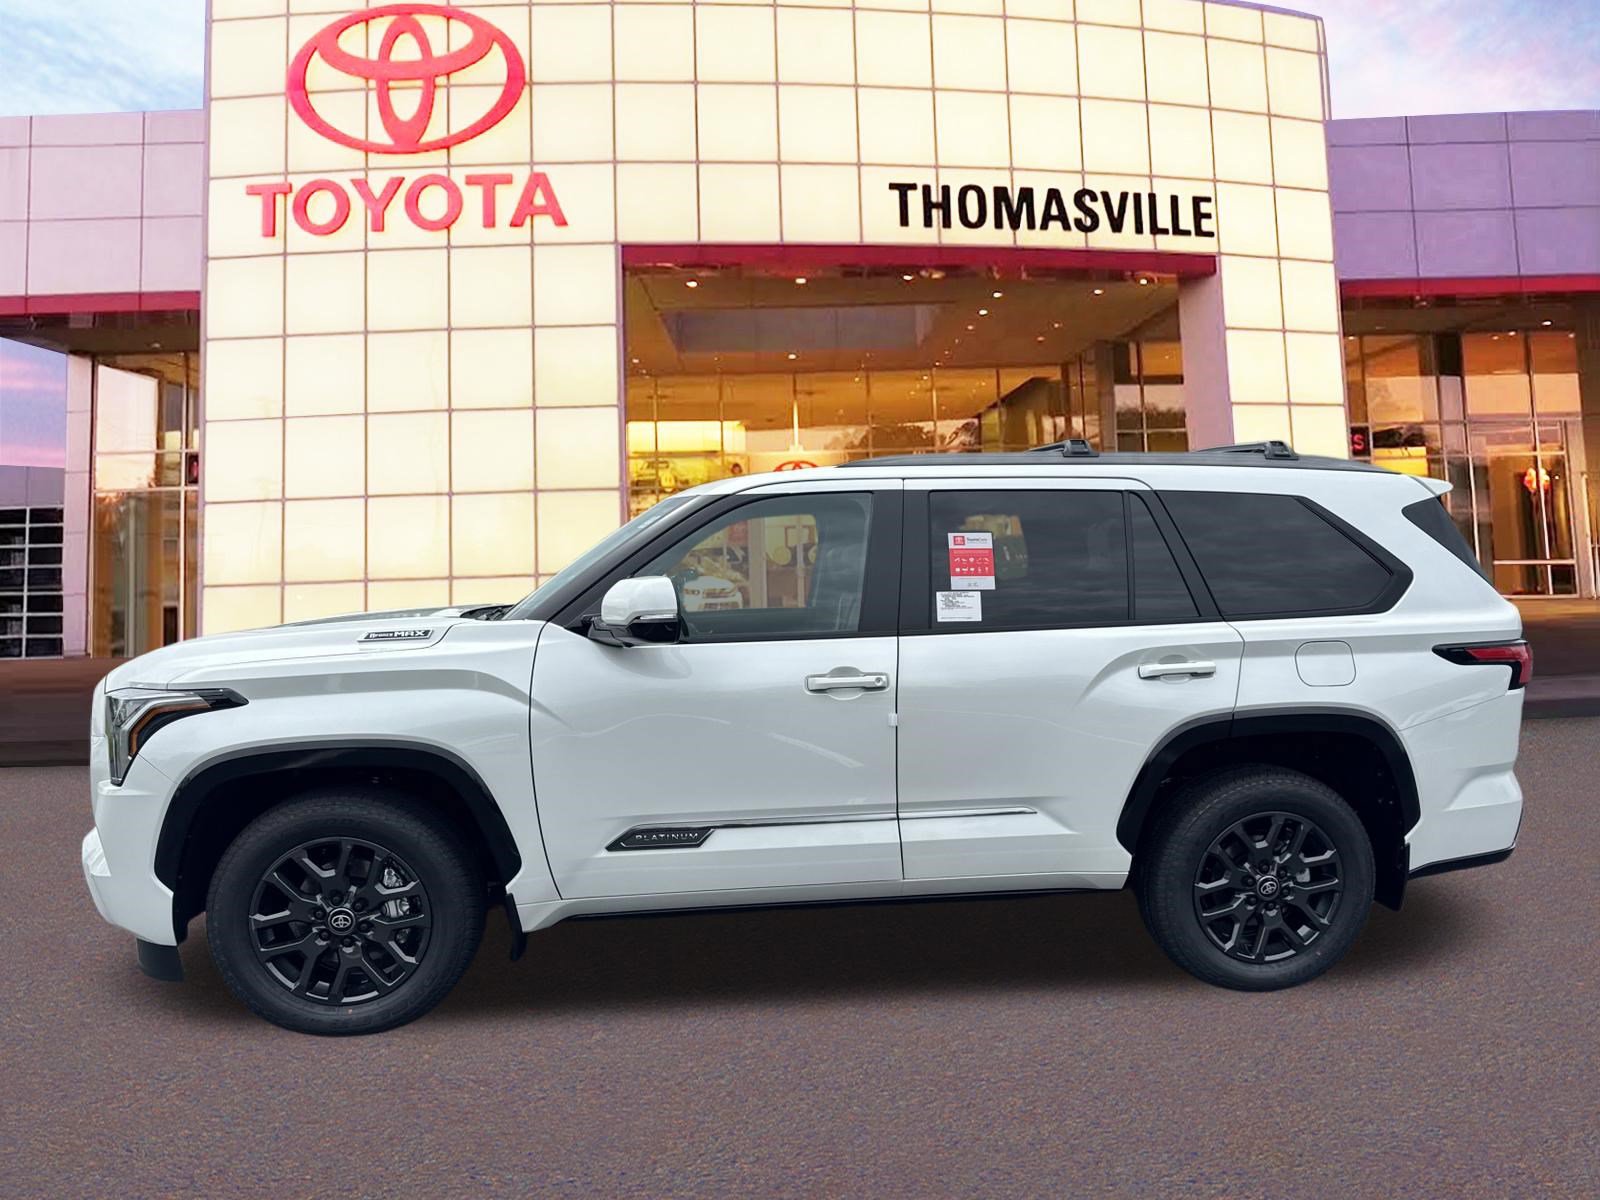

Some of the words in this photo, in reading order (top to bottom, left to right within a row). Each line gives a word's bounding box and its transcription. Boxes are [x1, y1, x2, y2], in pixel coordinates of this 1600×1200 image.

[246, 172, 568, 238] TOYOTA
[888, 182, 1216, 238] THOMASVILLE
[635, 833, 698, 841] PLATINUM
